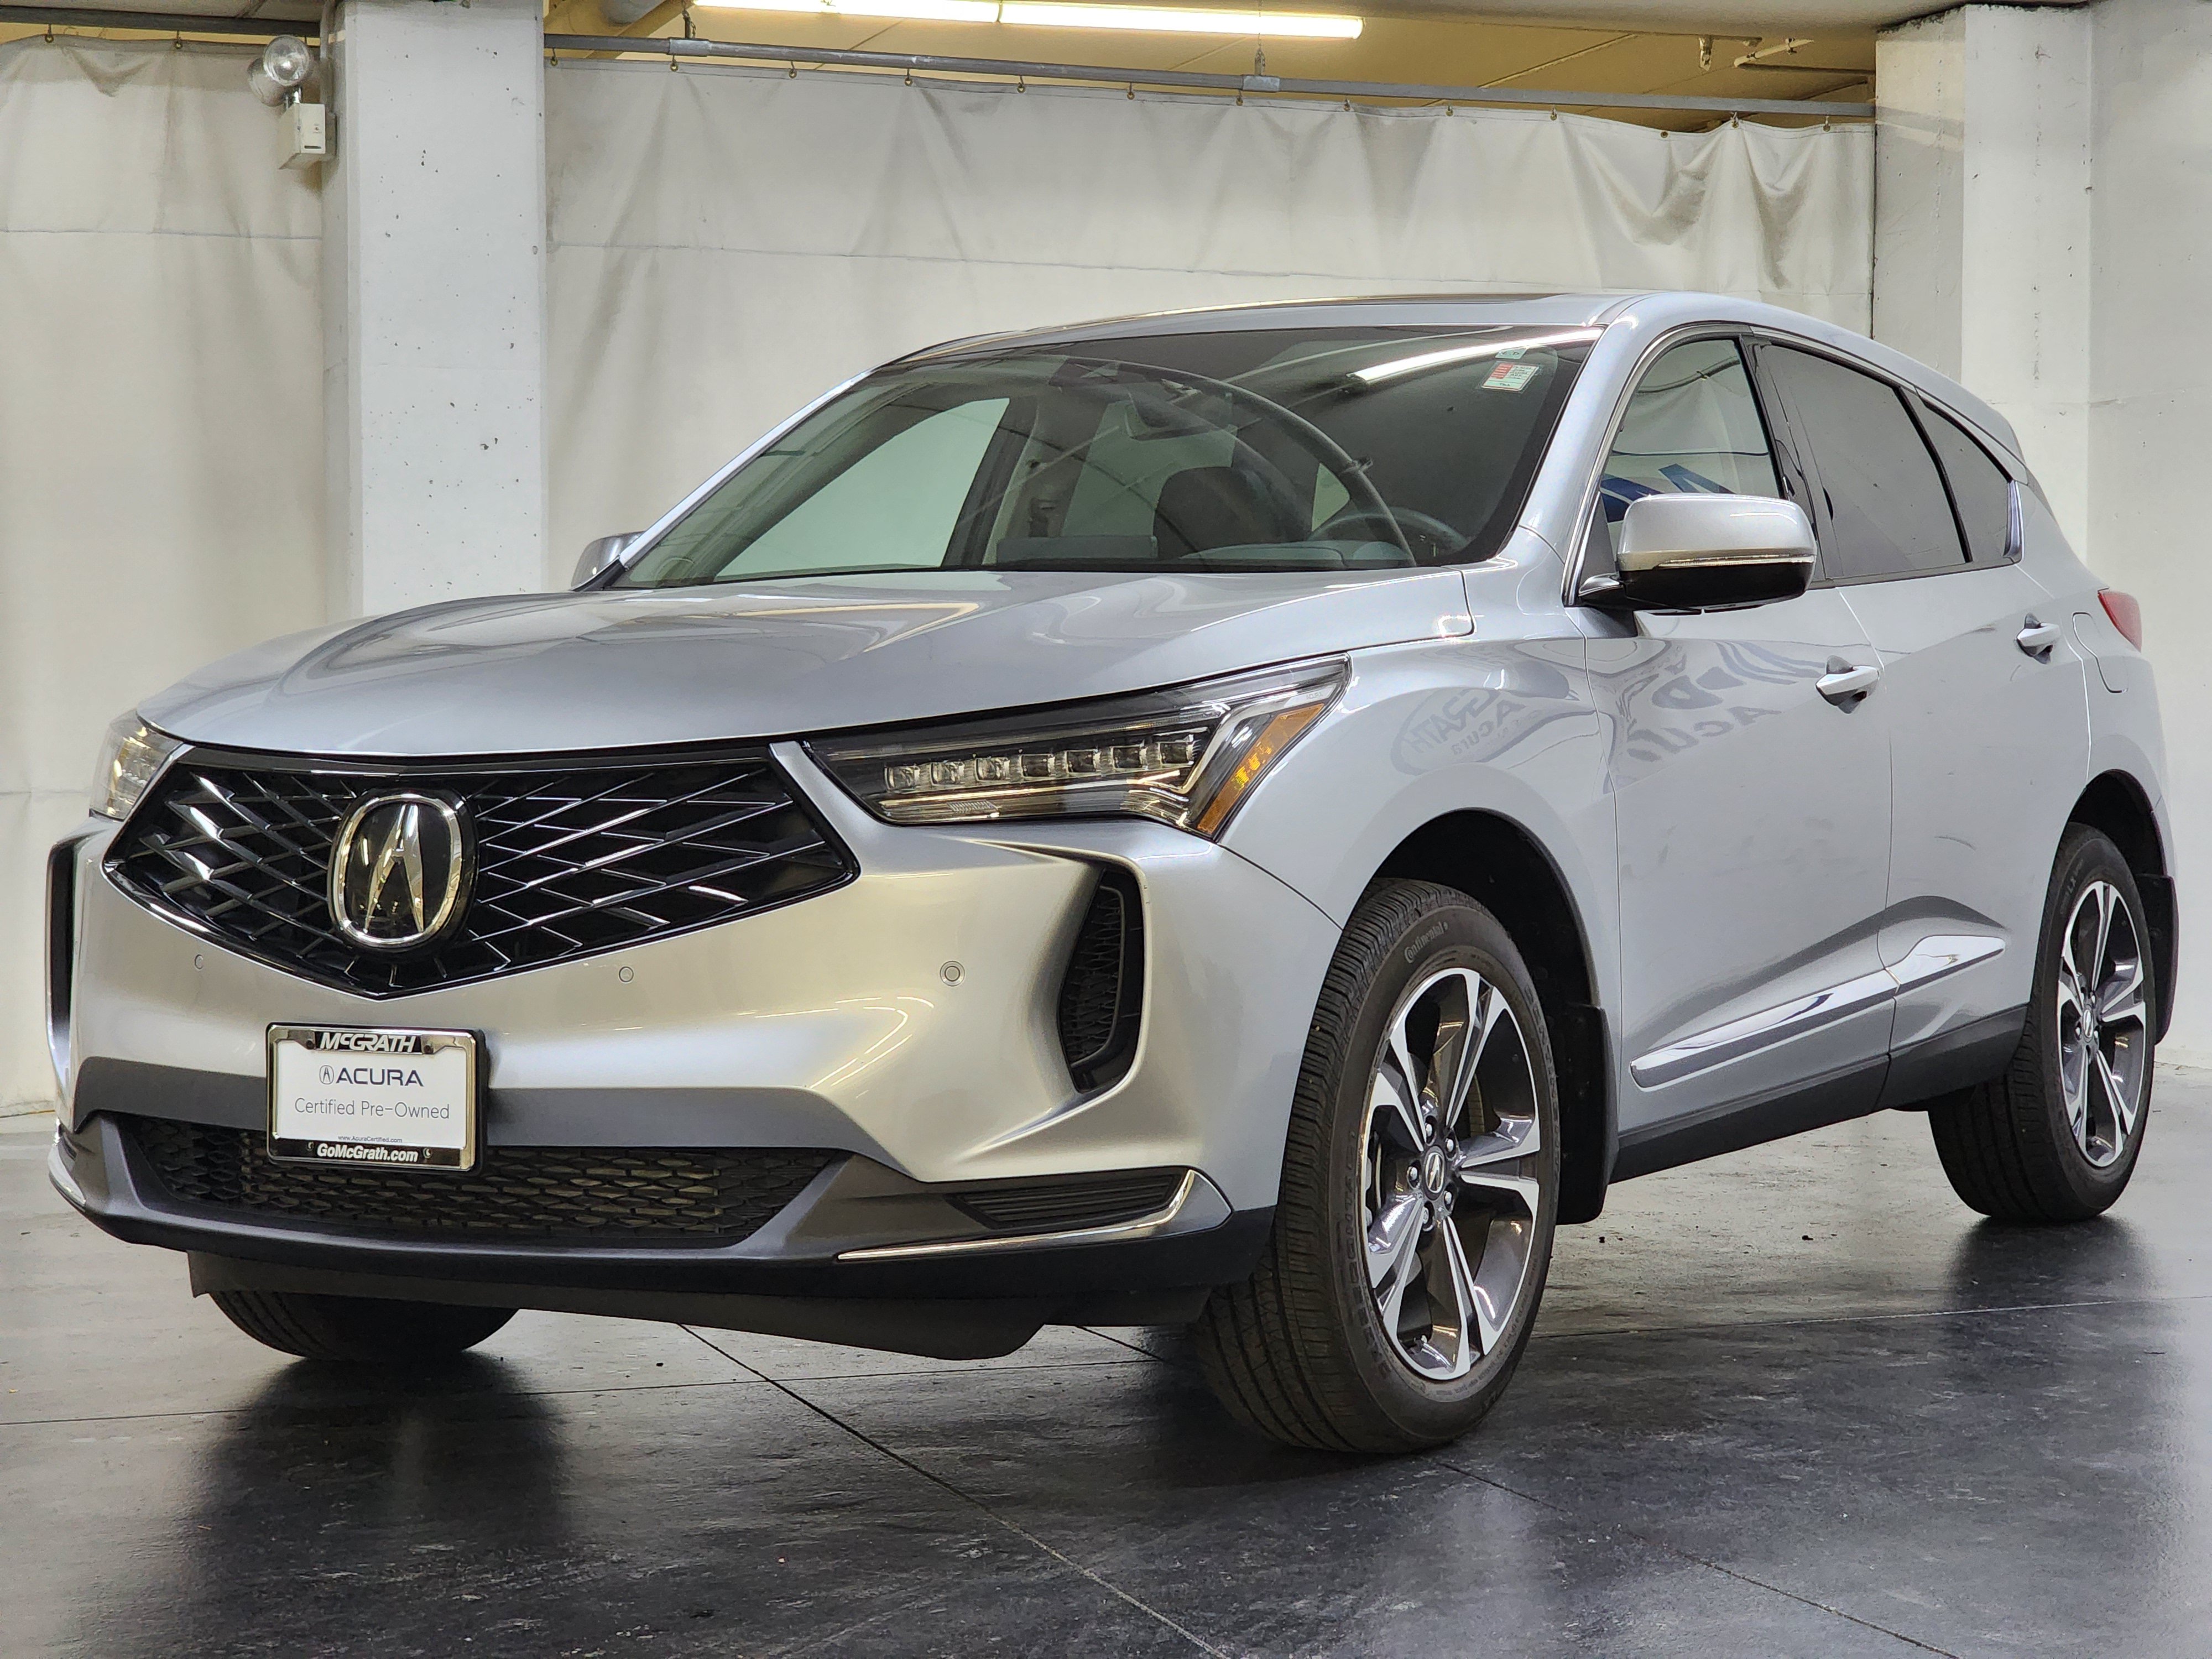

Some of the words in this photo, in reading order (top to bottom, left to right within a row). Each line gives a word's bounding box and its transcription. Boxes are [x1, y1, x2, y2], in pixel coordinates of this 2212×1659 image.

[1405, 921, 1444, 963] Continental
[335, 1067, 424, 1087] ACURA
[295, 1097, 354, 1115] Certified
[361, 1100, 450, 1119] Pre-Owned
[338, 1135, 403, 1143] www.AcuraCertified.com
[317, 1142, 419, 1162] GoMcGrath.com
